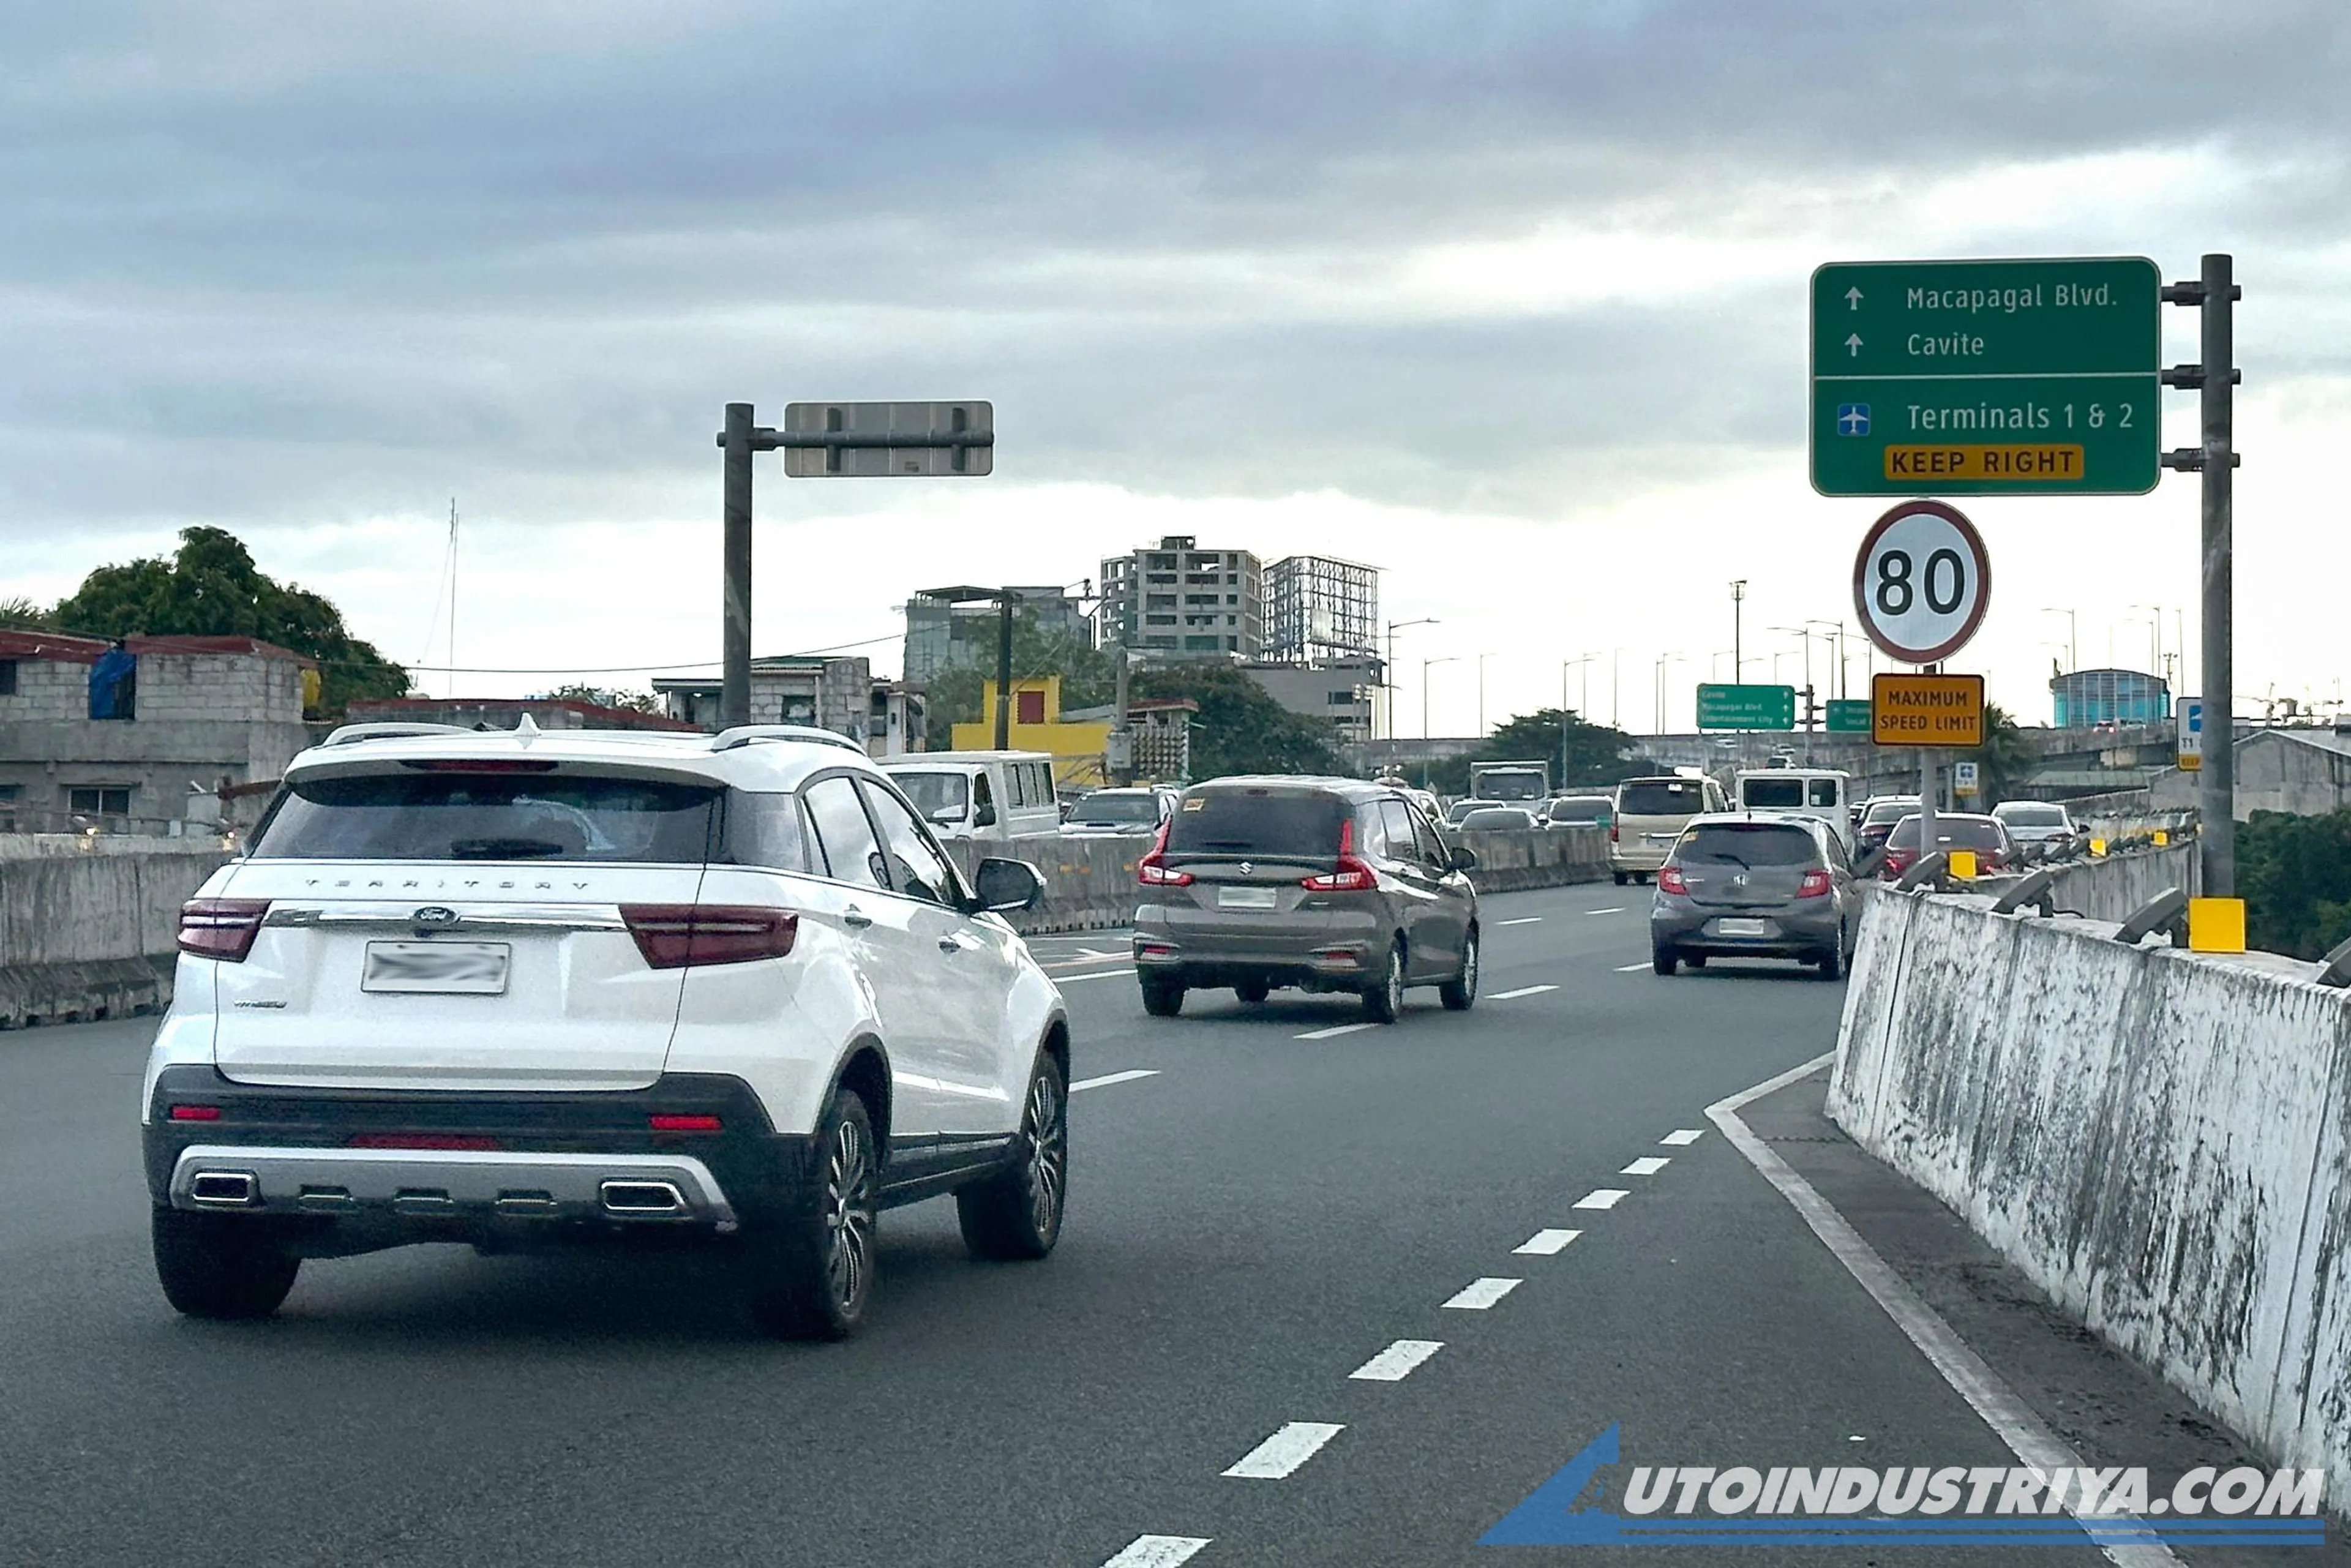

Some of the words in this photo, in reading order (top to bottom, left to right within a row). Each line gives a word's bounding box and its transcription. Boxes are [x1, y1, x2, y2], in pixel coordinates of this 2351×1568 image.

[1908, 284, 2042, 313] Macapagal
[2055, 283, 2117, 306] Blvd.
[1908, 332, 1984, 356] Cavite
[1908, 402, 2049, 429] Terminals
[2064, 403, 2073, 428] 1
[2088, 403, 2105, 428] &
[2120, 403, 2133, 428] 2
[1892, 452, 1965, 473] KEEP
[1984, 451, 2074, 473] RIGHT
[1877, 548, 1965, 616] 80
[1888, 690, 1968, 707] MAXIMUM
[1880, 715, 1927, 730] SPEED
[1935, 715, 1976, 731] LIMIT
